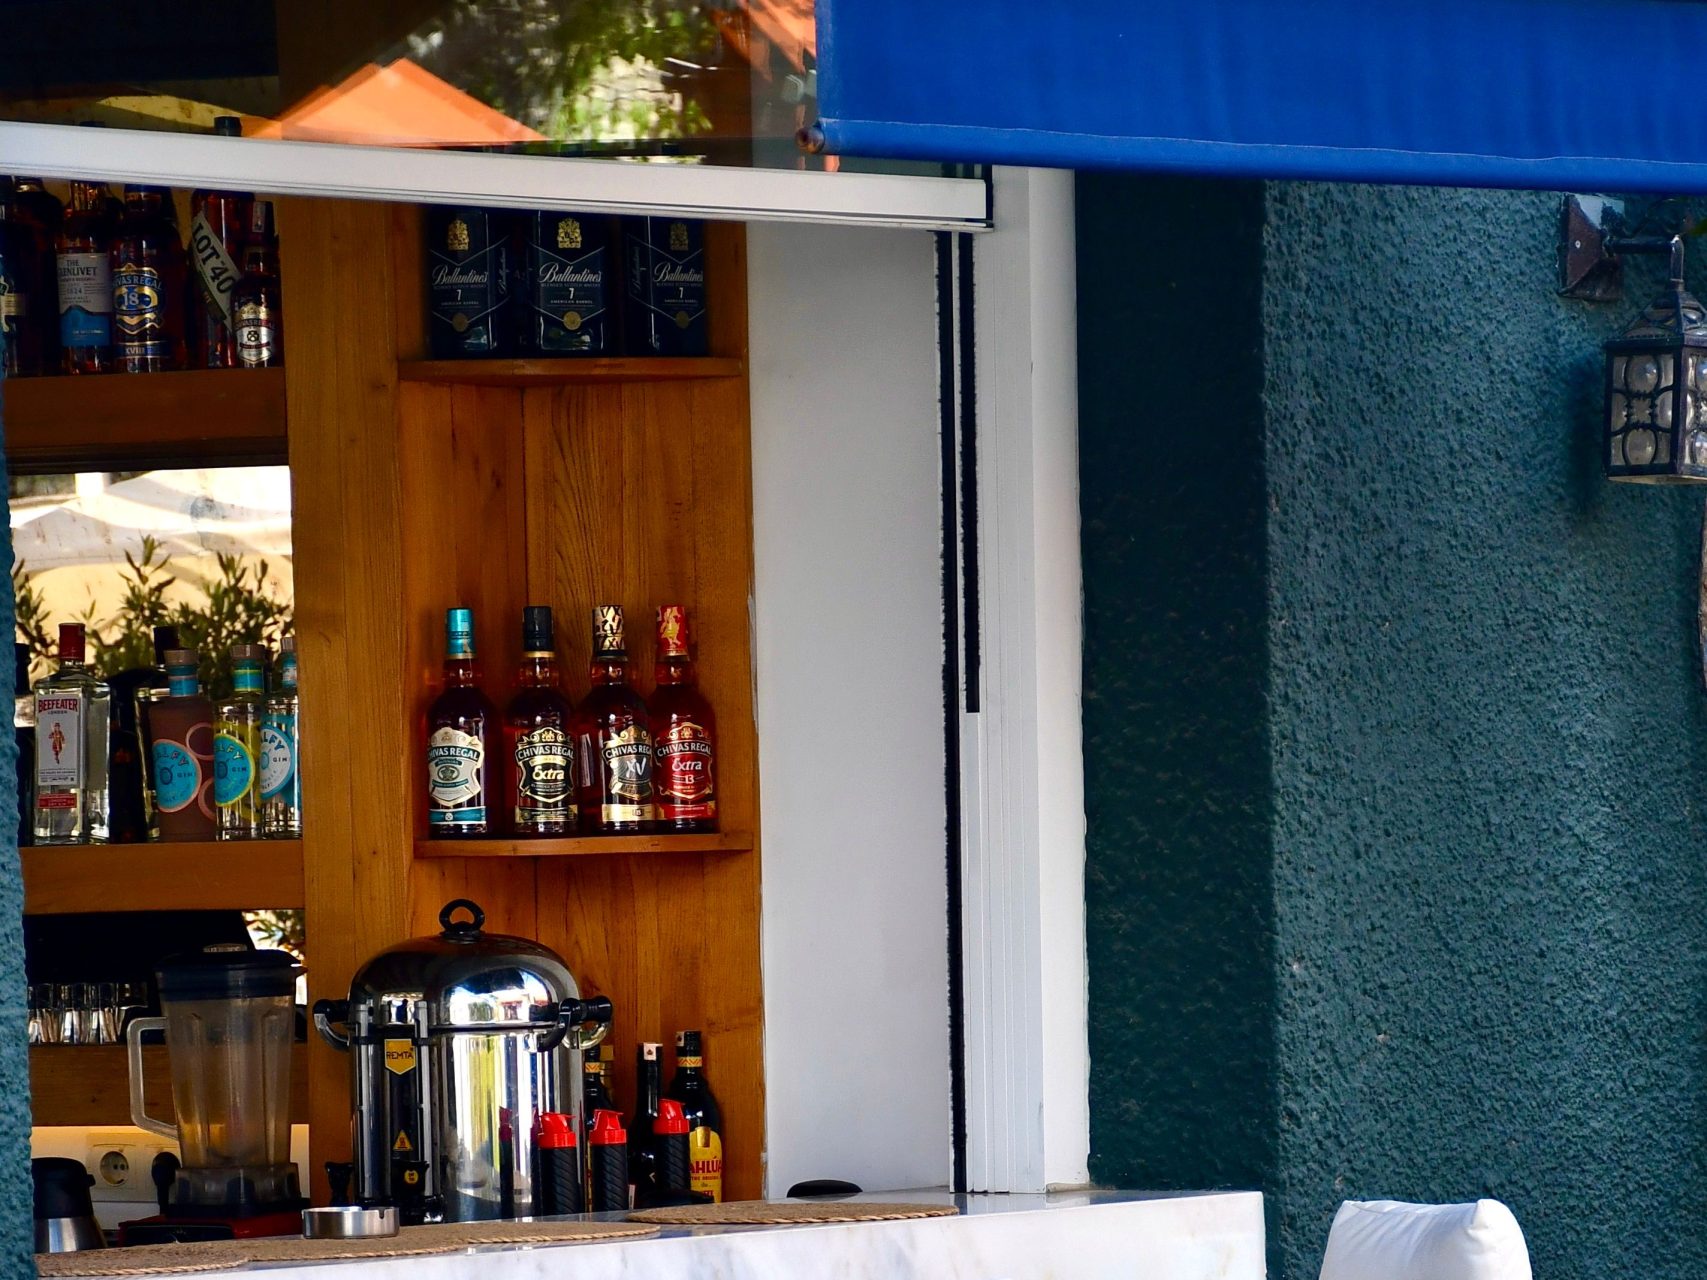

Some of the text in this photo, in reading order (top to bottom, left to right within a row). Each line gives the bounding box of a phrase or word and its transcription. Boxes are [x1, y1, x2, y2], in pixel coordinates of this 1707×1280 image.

[538, 261, 602, 283] Ballantine's
[123, 292, 140, 306] 18
[38, 698, 78, 713] BEEFEATER
[450, 747, 479, 761] REGAL
[517, 745, 575, 760] CHIVAS REGAL
[605, 744, 638, 758] CHIVAS
[657, 742, 712, 757] CHIVAS REGAL
[626, 756, 647, 778] XV
[672, 758, 702, 772] Extra
[532, 766, 565, 780] Extra
[386, 1051, 413, 1060] REMTA
